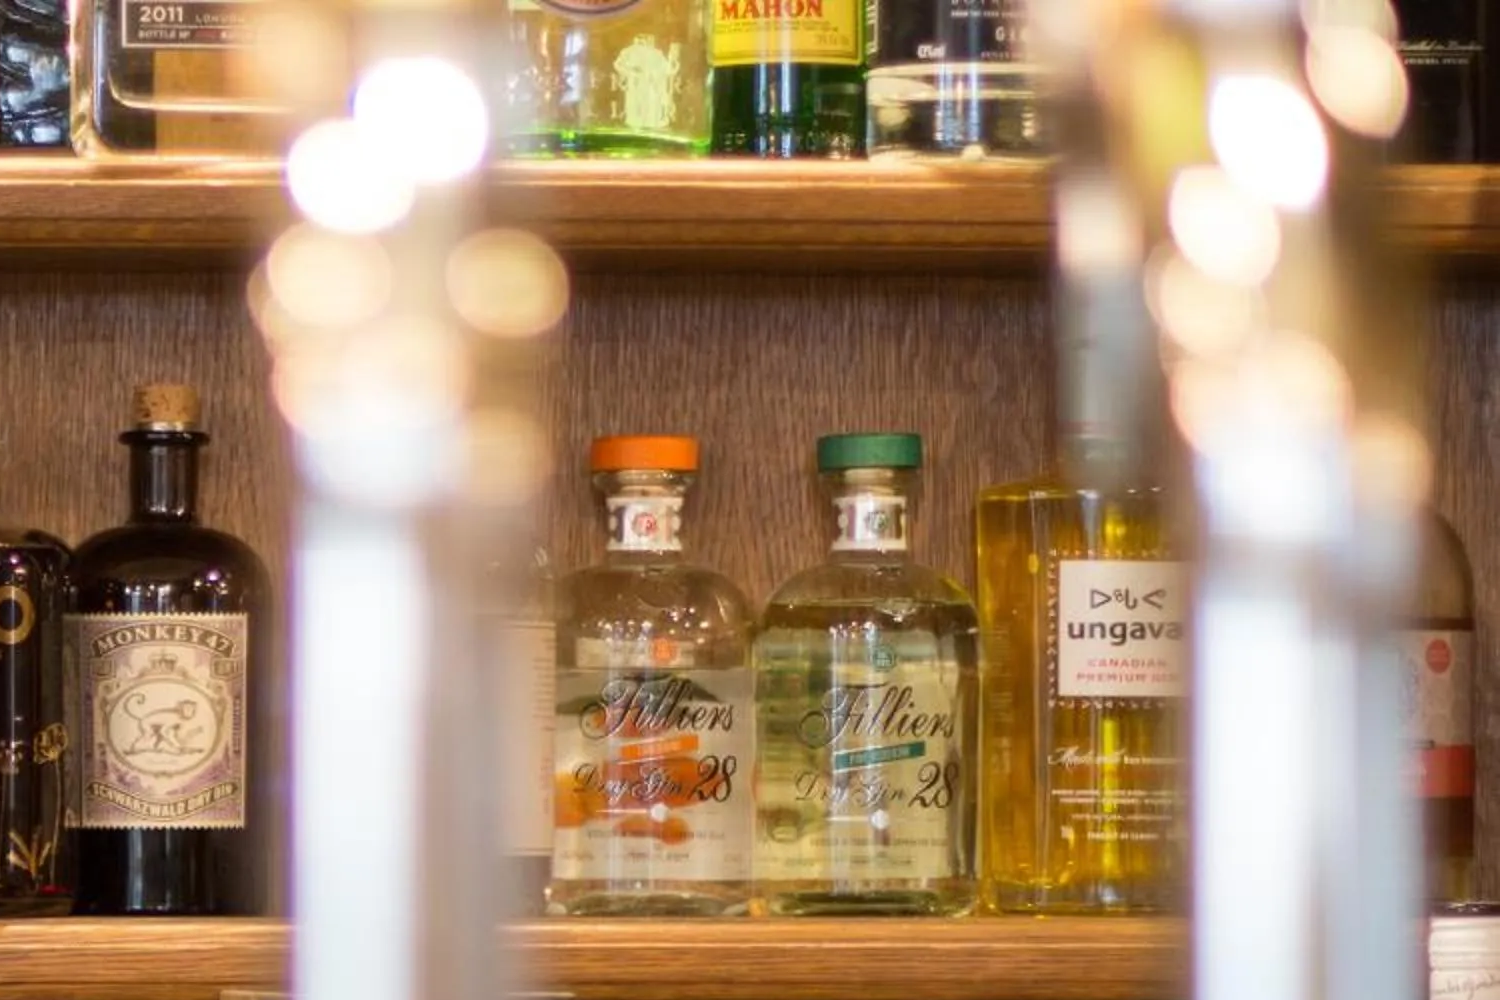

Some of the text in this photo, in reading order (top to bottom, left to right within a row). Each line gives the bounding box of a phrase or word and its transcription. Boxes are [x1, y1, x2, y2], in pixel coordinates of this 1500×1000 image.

[140, 6, 183, 22] 2011
[97, 624, 231, 652] MONKEY 47
[1067, 621, 1183, 646] ungava
[1087, 658, 1167, 668] CANADIAN
[1077, 673, 1147, 683] PREMIUM
[799, 682, 956, 749] Filliers
[688, 755, 738, 802] 28
[908, 761, 959, 808] 28
